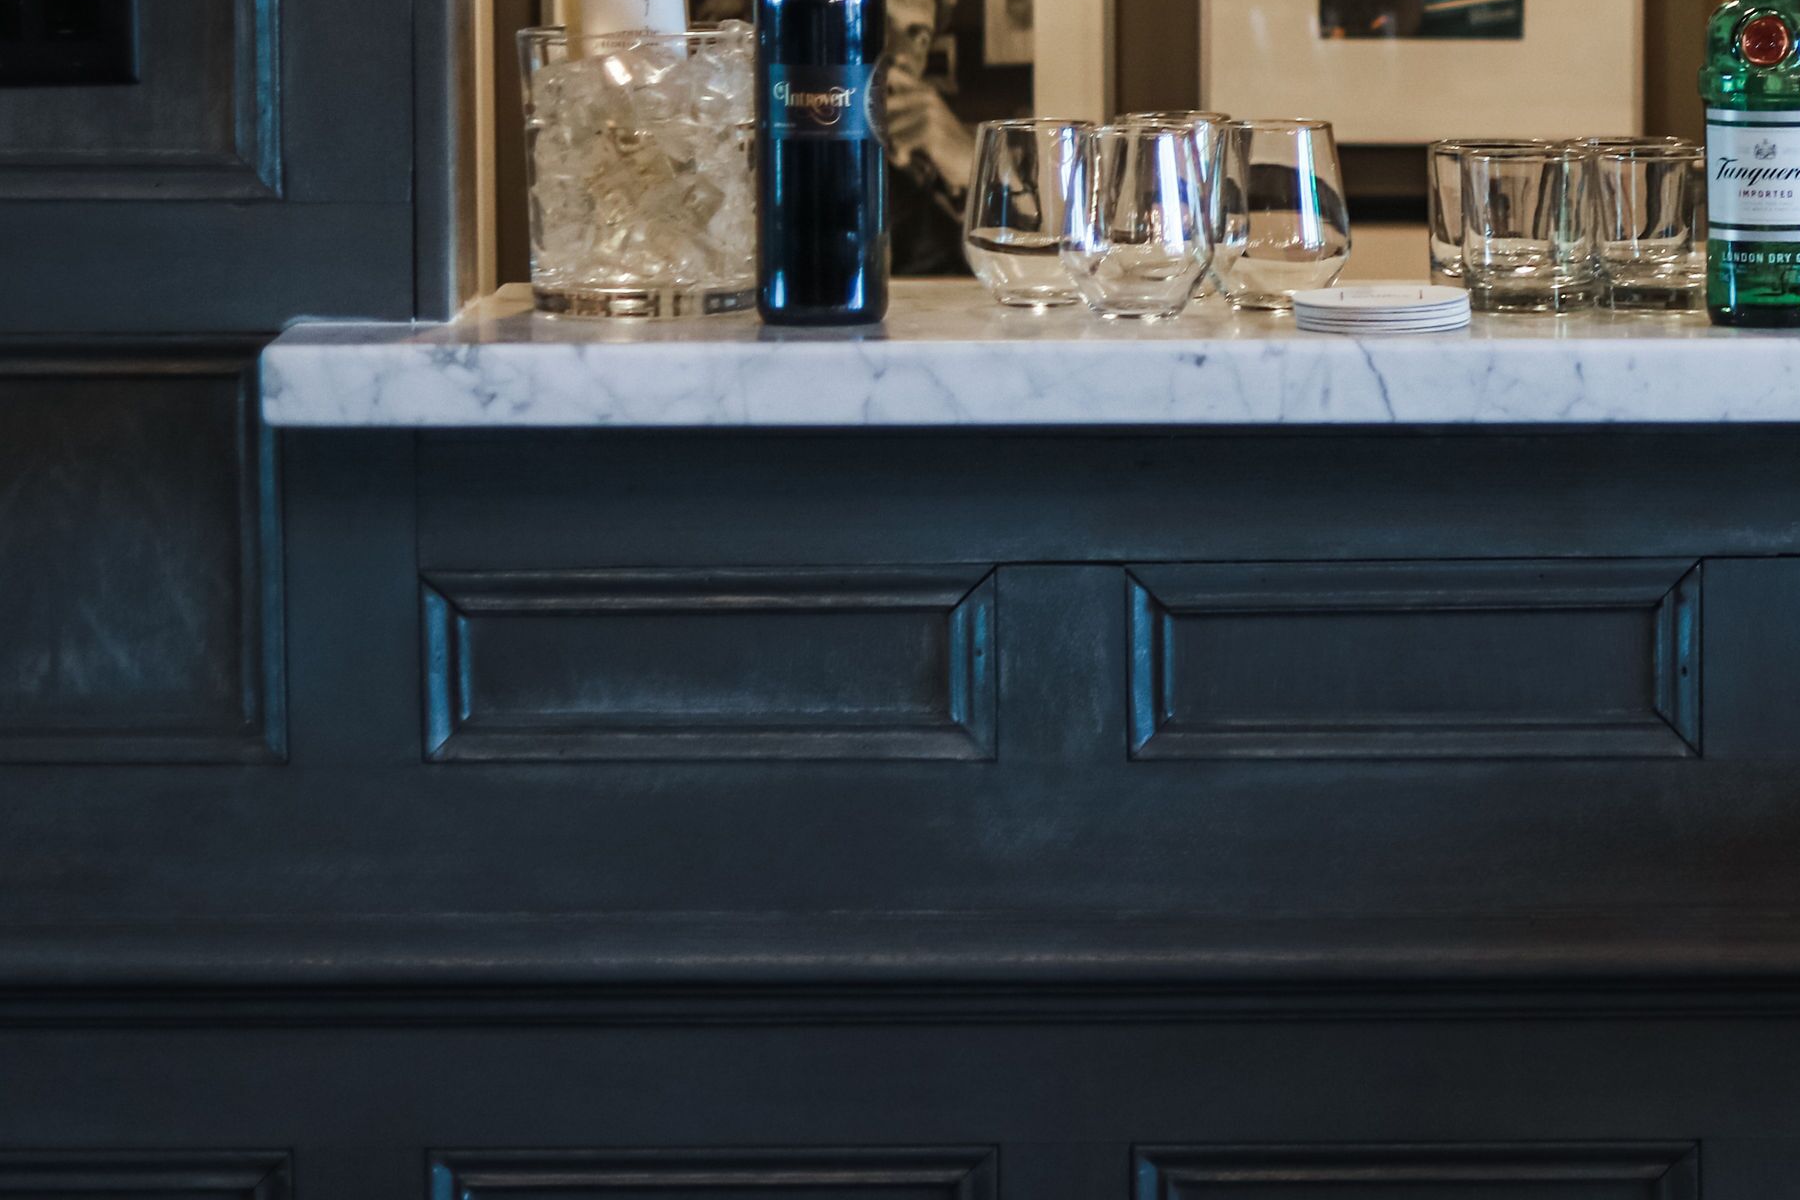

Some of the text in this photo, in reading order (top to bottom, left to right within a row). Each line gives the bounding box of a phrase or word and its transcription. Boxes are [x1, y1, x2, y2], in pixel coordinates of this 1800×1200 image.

[773, 81, 857, 125] Introvert
[1738, 190, 1794, 199] IMPORTED
[1722, 252, 1764, 263] LONDON
[1768, 252, 1792, 263] DRY
